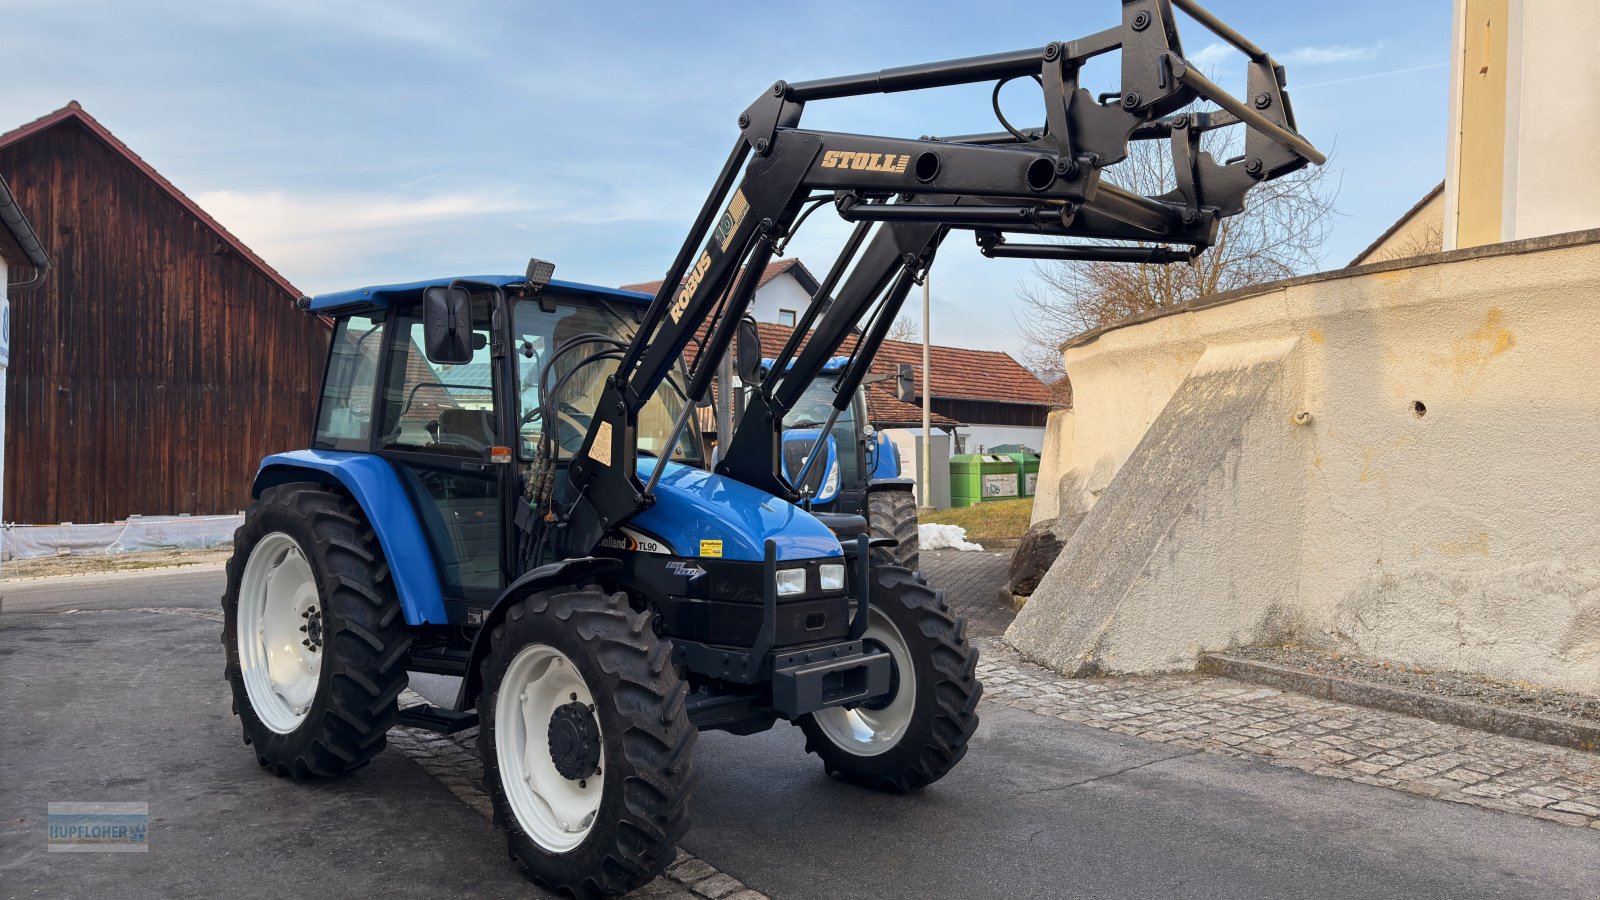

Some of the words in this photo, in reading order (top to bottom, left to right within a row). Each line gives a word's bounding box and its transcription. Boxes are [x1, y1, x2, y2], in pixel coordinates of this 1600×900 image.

[821, 150, 897, 173] STOLL
[670, 249, 712, 325] ROBUS
[638, 541, 657, 552] TL90
